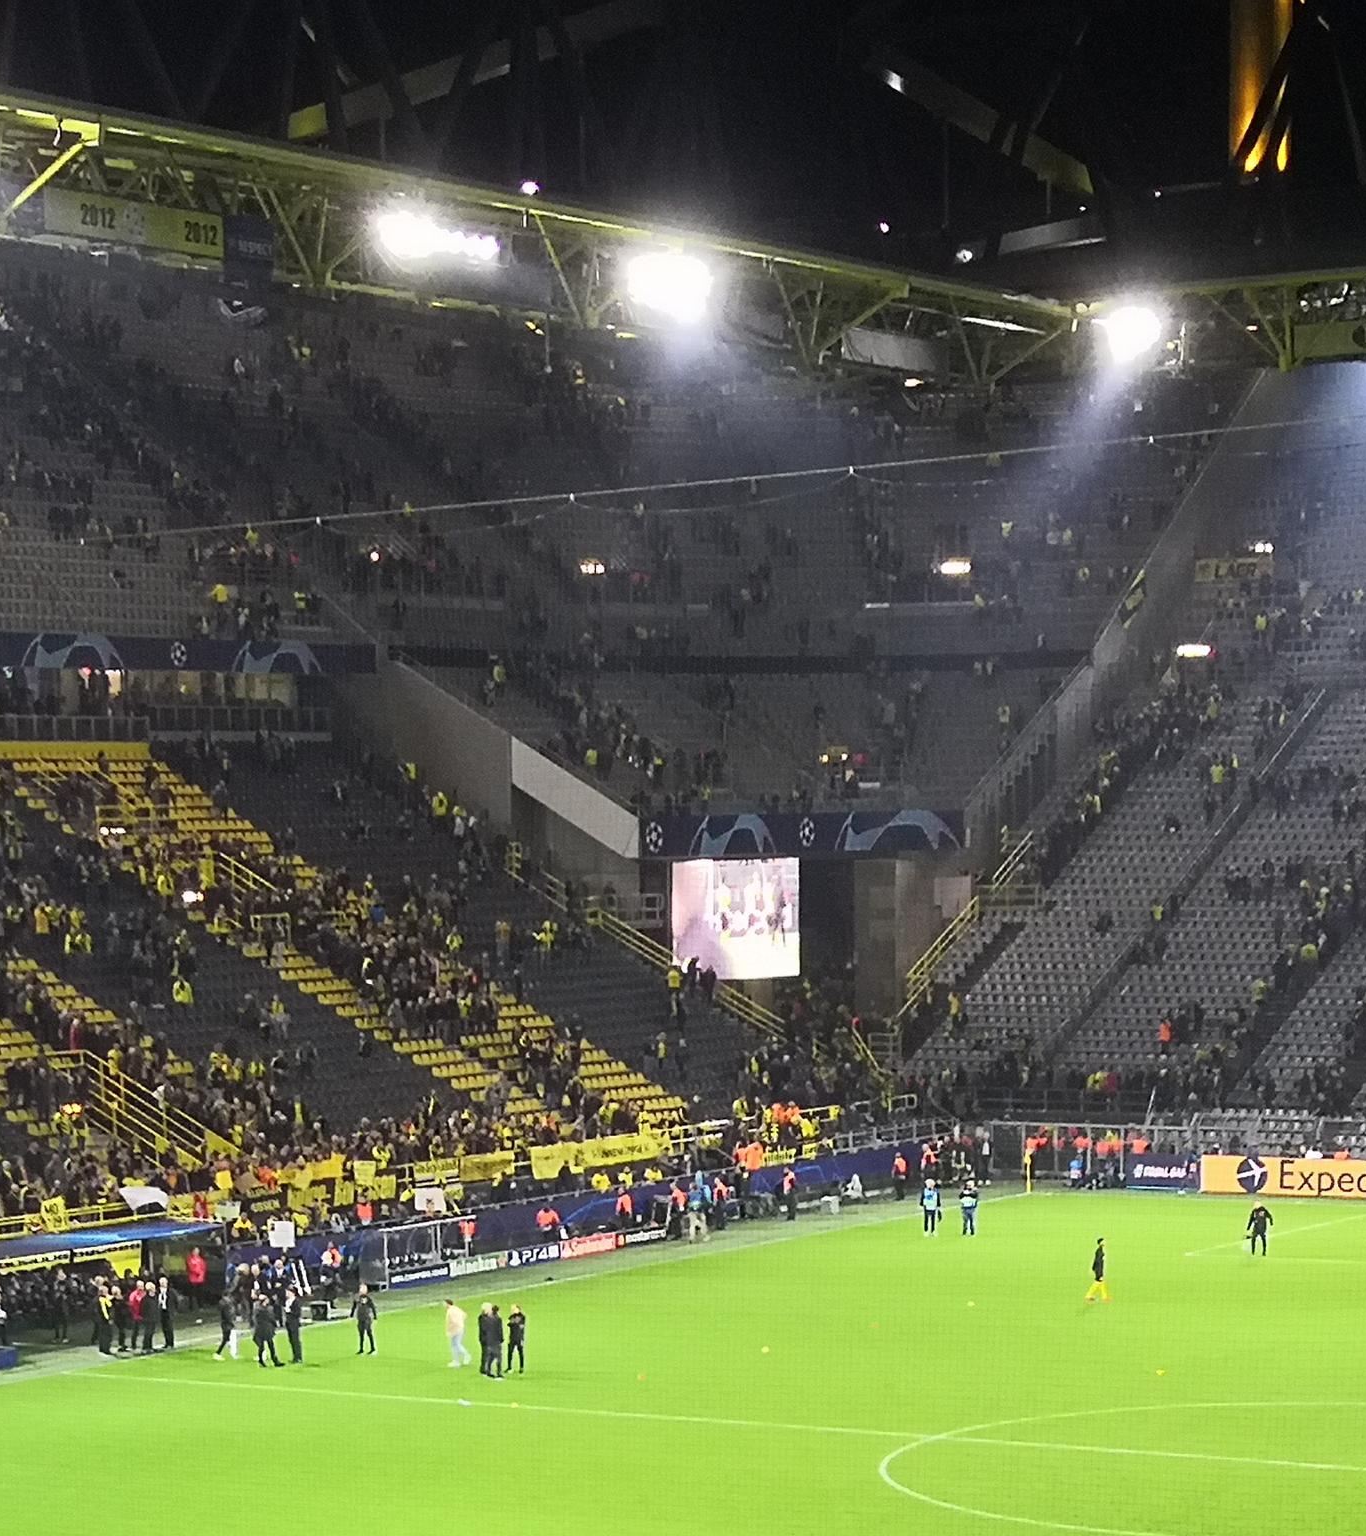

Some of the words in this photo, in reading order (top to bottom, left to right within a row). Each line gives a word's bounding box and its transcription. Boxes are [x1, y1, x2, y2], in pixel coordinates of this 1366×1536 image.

[80, 203, 116, 229] 2012
[185, 221, 217, 246] 2012
[521, 1246, 549, 1264] PS4
